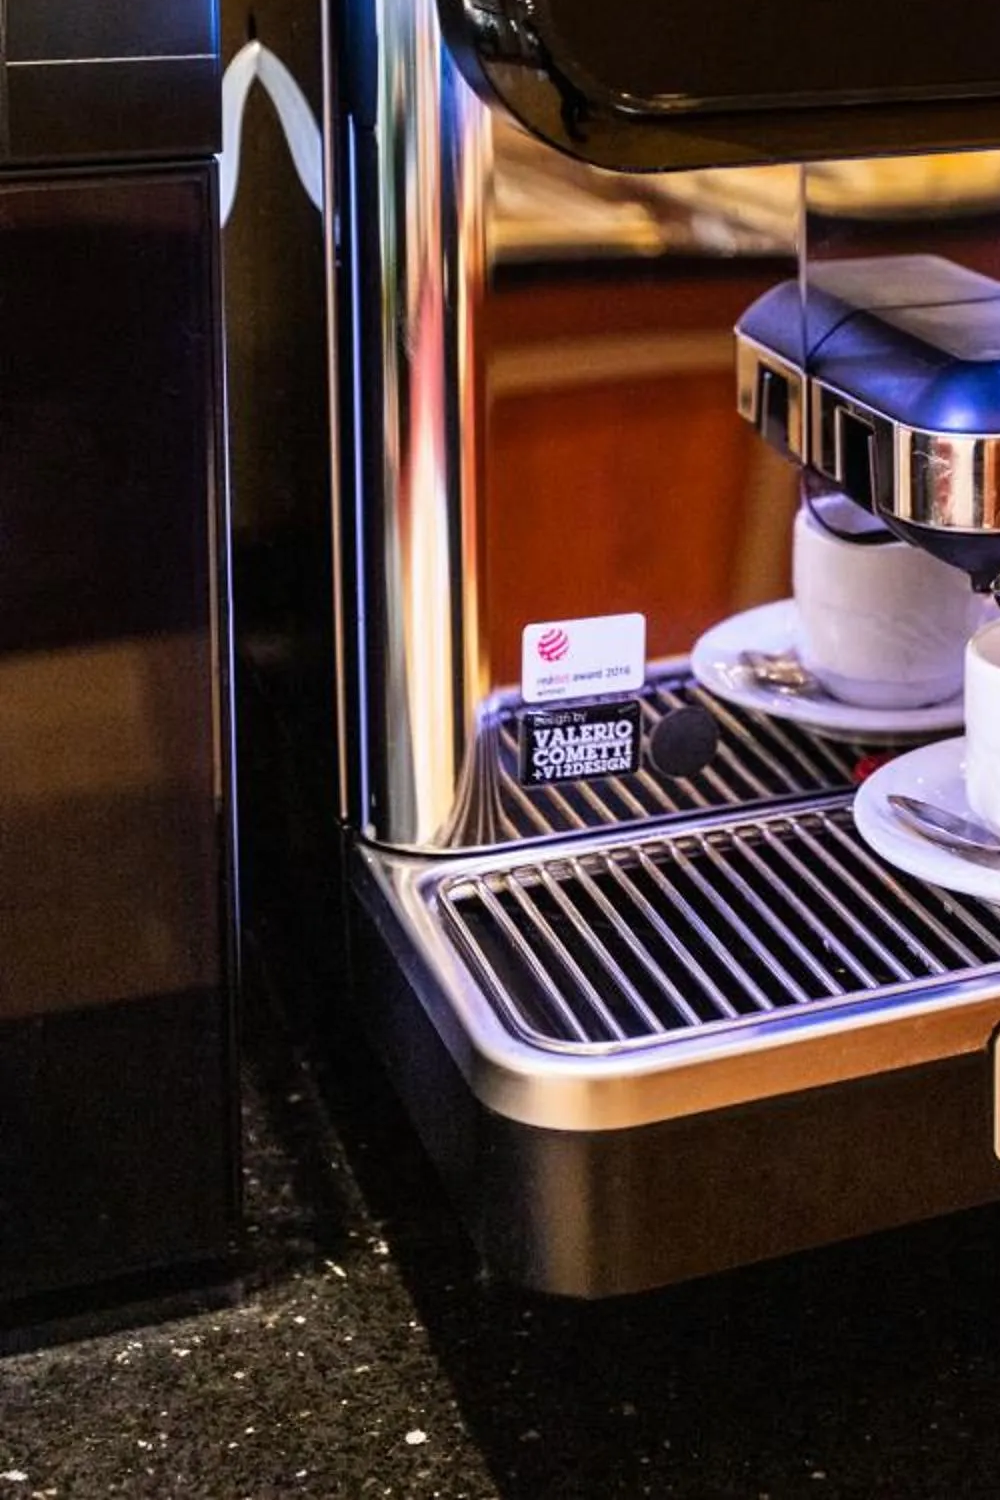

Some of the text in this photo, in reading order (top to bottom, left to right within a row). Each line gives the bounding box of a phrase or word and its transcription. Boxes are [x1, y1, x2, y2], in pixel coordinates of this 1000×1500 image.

[533, 719, 633, 749] VALERIO
[532, 738, 632, 767] COMETTI
[532, 757, 632, 780] +V12DESIGN
